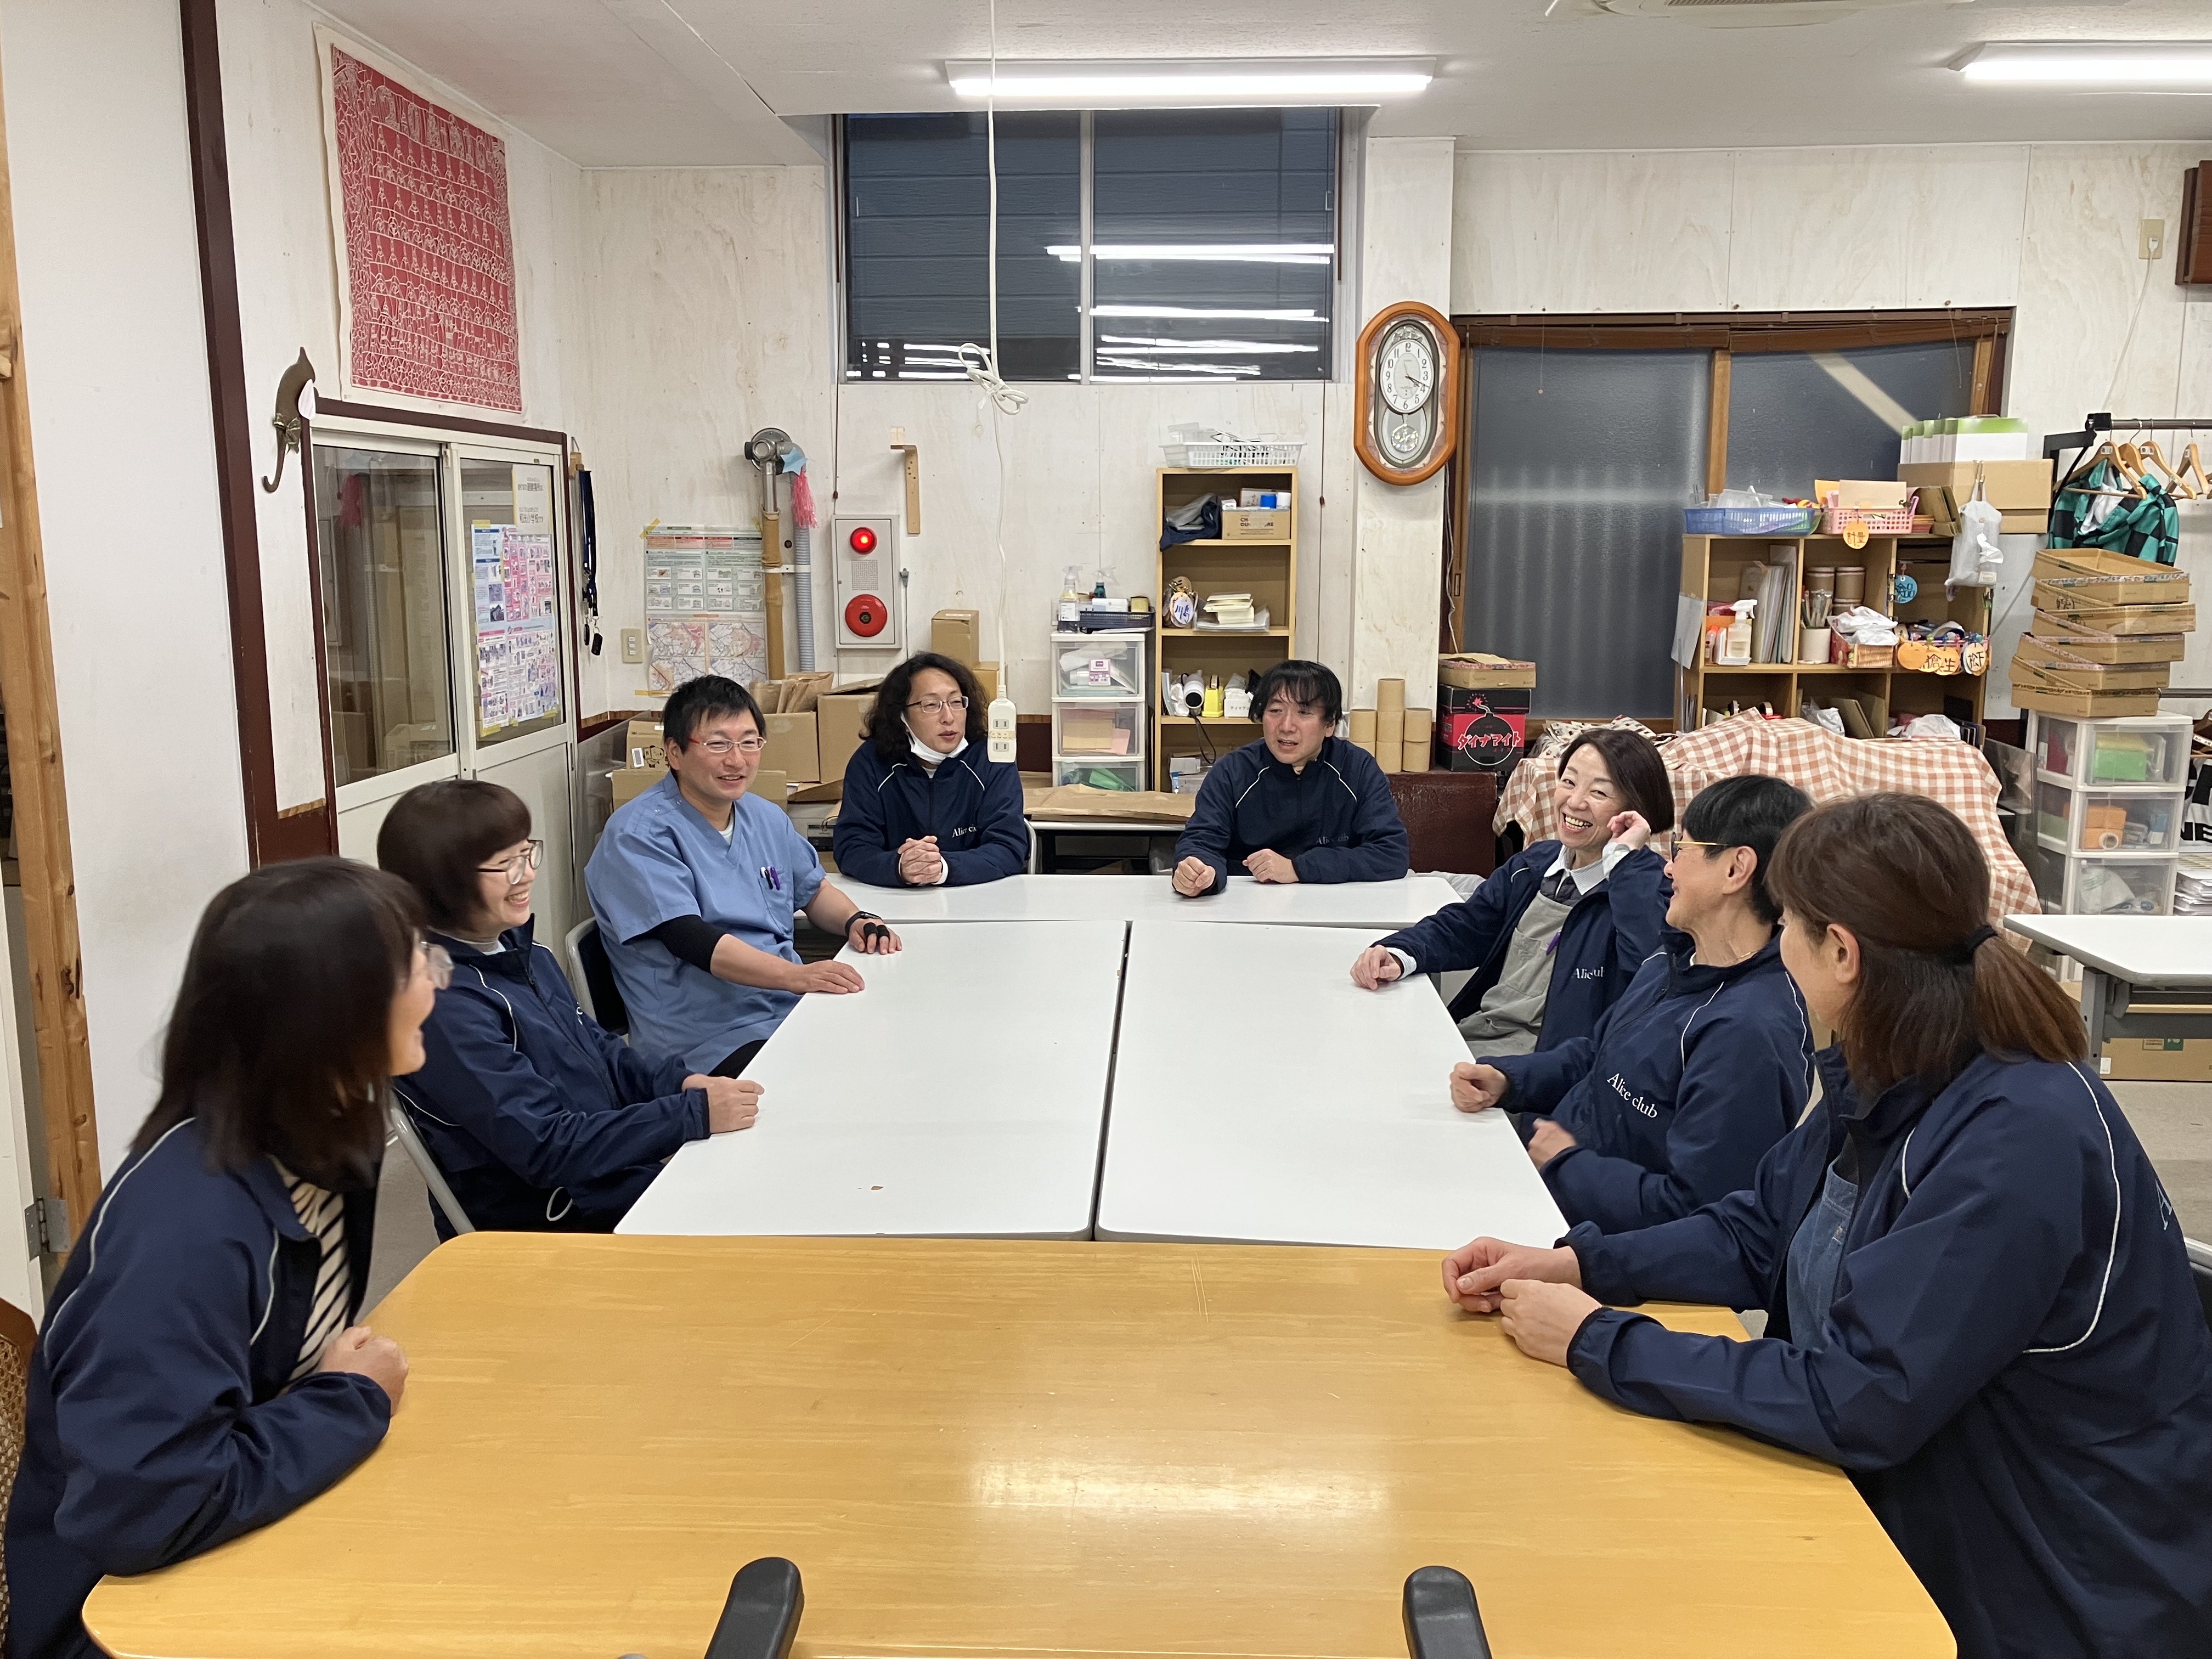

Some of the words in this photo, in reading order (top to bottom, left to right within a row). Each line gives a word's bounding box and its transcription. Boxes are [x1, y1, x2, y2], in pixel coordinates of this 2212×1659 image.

[1405, 342, 1411, 352] 12
[1394, 348, 1399, 358] 11
[1388, 359, 1393, 368] 10
[1421, 359, 1427, 368] 2
[1386, 371, 1390, 381] 9
[1423, 371, 1428, 381] 3
[1387, 383, 1392, 393] 8
[1420, 384, 1426, 393] 4
[1393, 394, 1398, 404] 7
[1414, 394, 1419, 404] 5
[1403, 400, 1408, 409] 6
[1968, 651, 1984, 669] 松下
[1458, 731, 1521, 751] ダイナマイト
[1607, 1073, 1631, 1101] Alice
[1632, 1097, 1657, 1118] club
